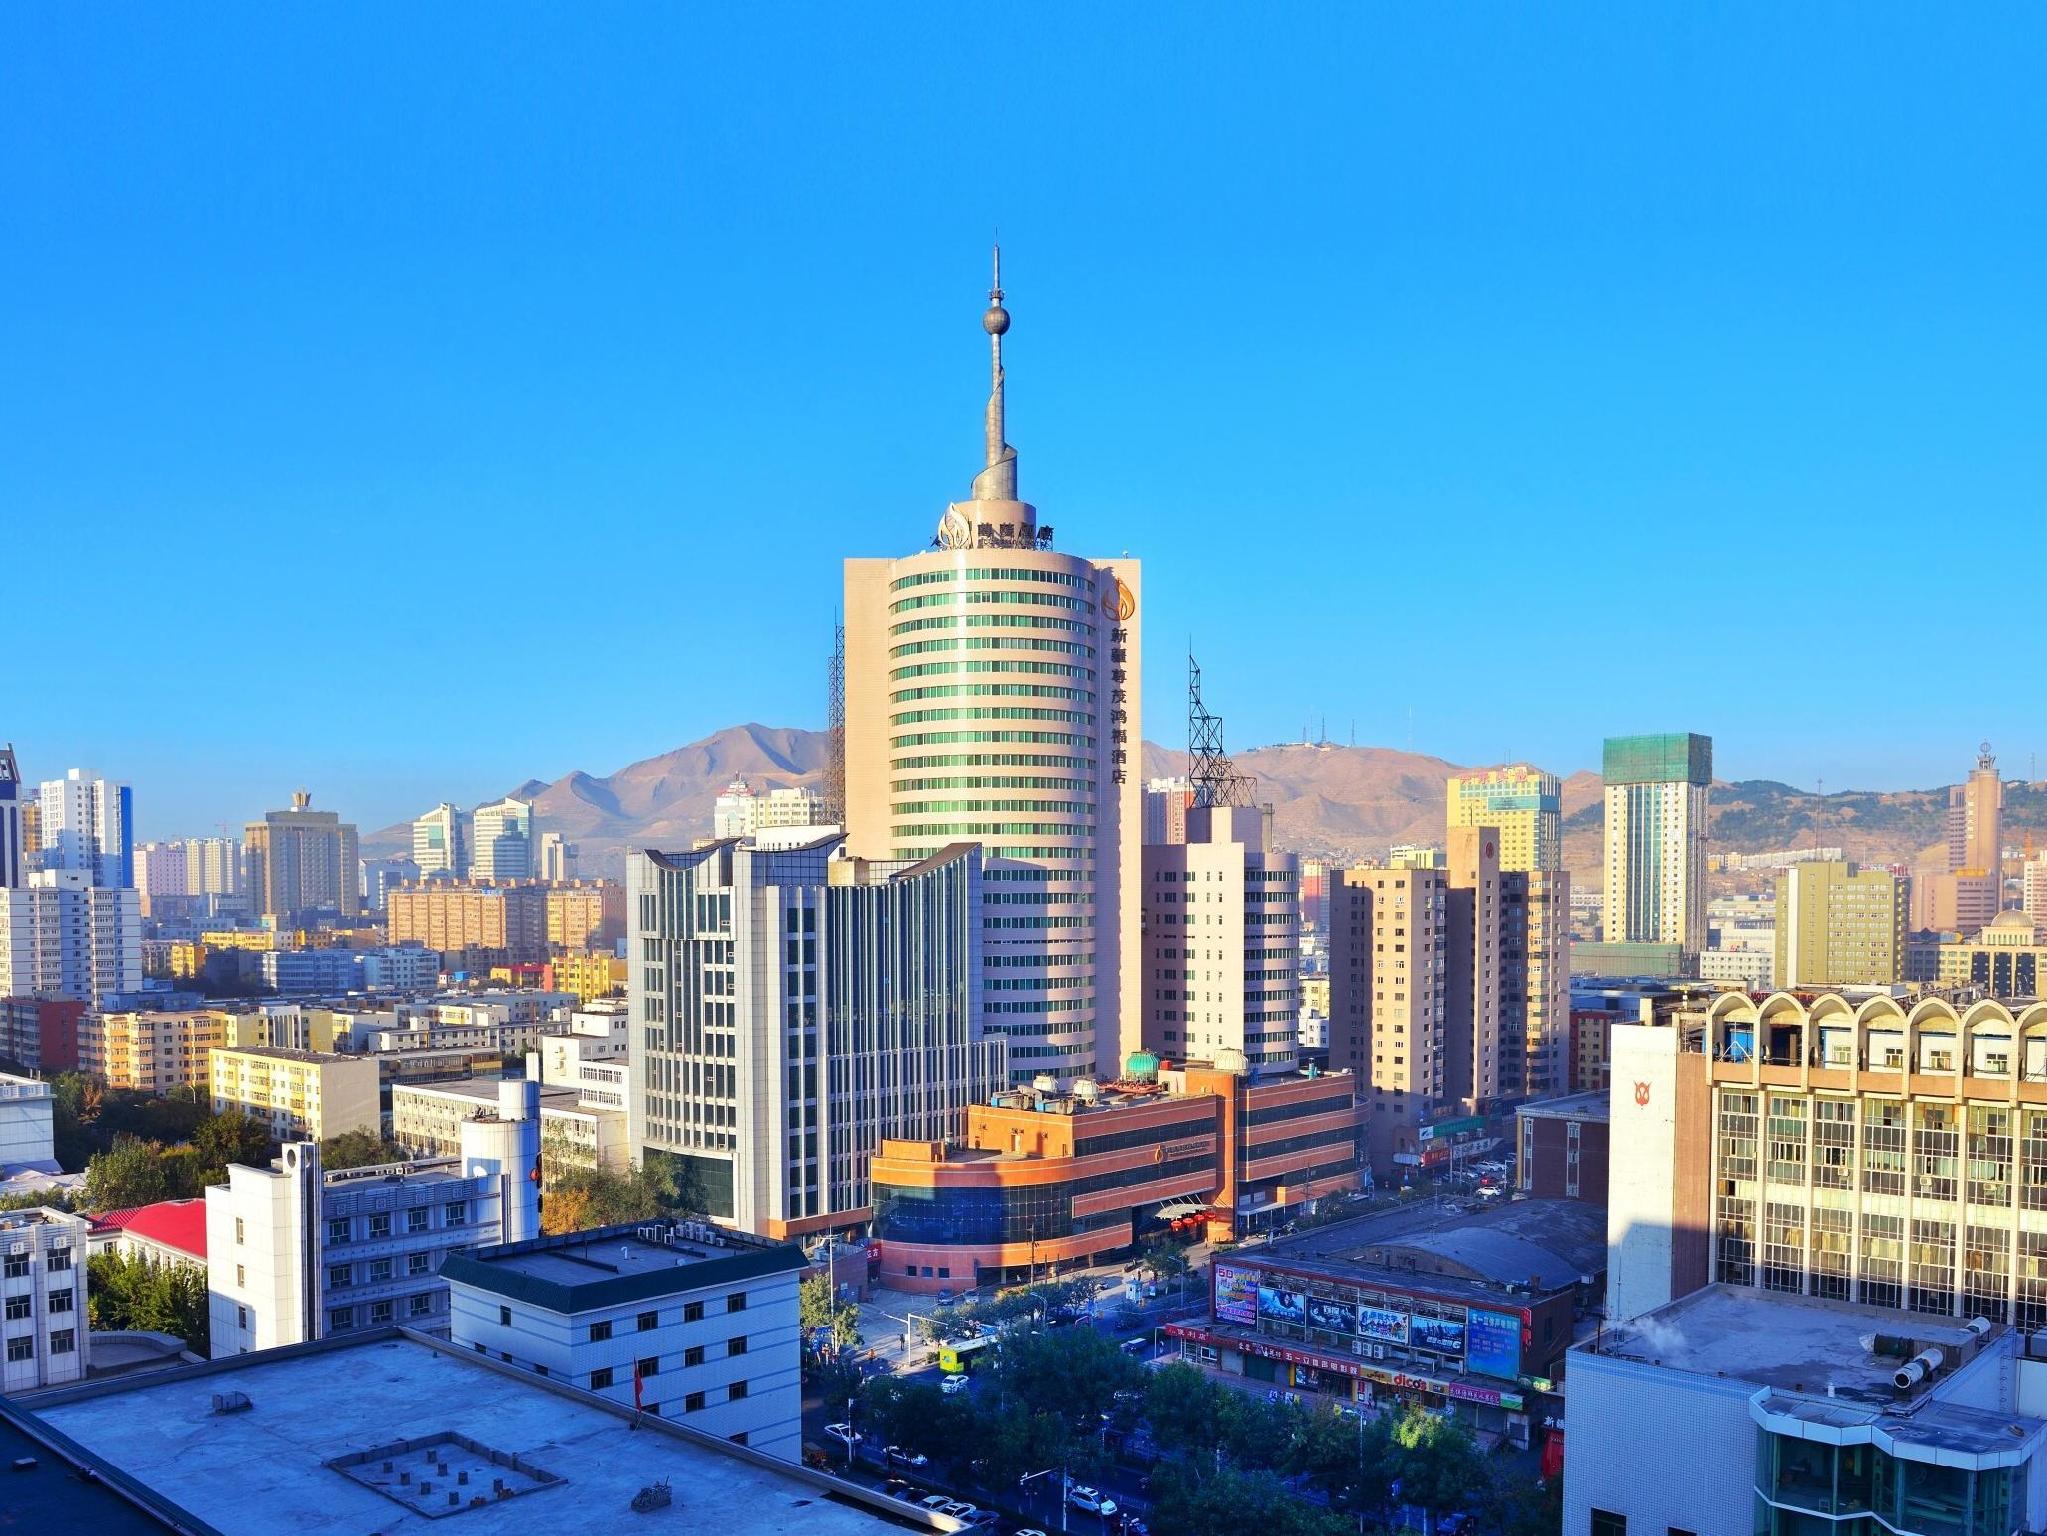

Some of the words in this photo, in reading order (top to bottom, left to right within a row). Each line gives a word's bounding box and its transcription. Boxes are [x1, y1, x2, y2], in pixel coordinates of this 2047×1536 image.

[1110, 628, 1128, 785] 新疆尊茂鸿福酒店
